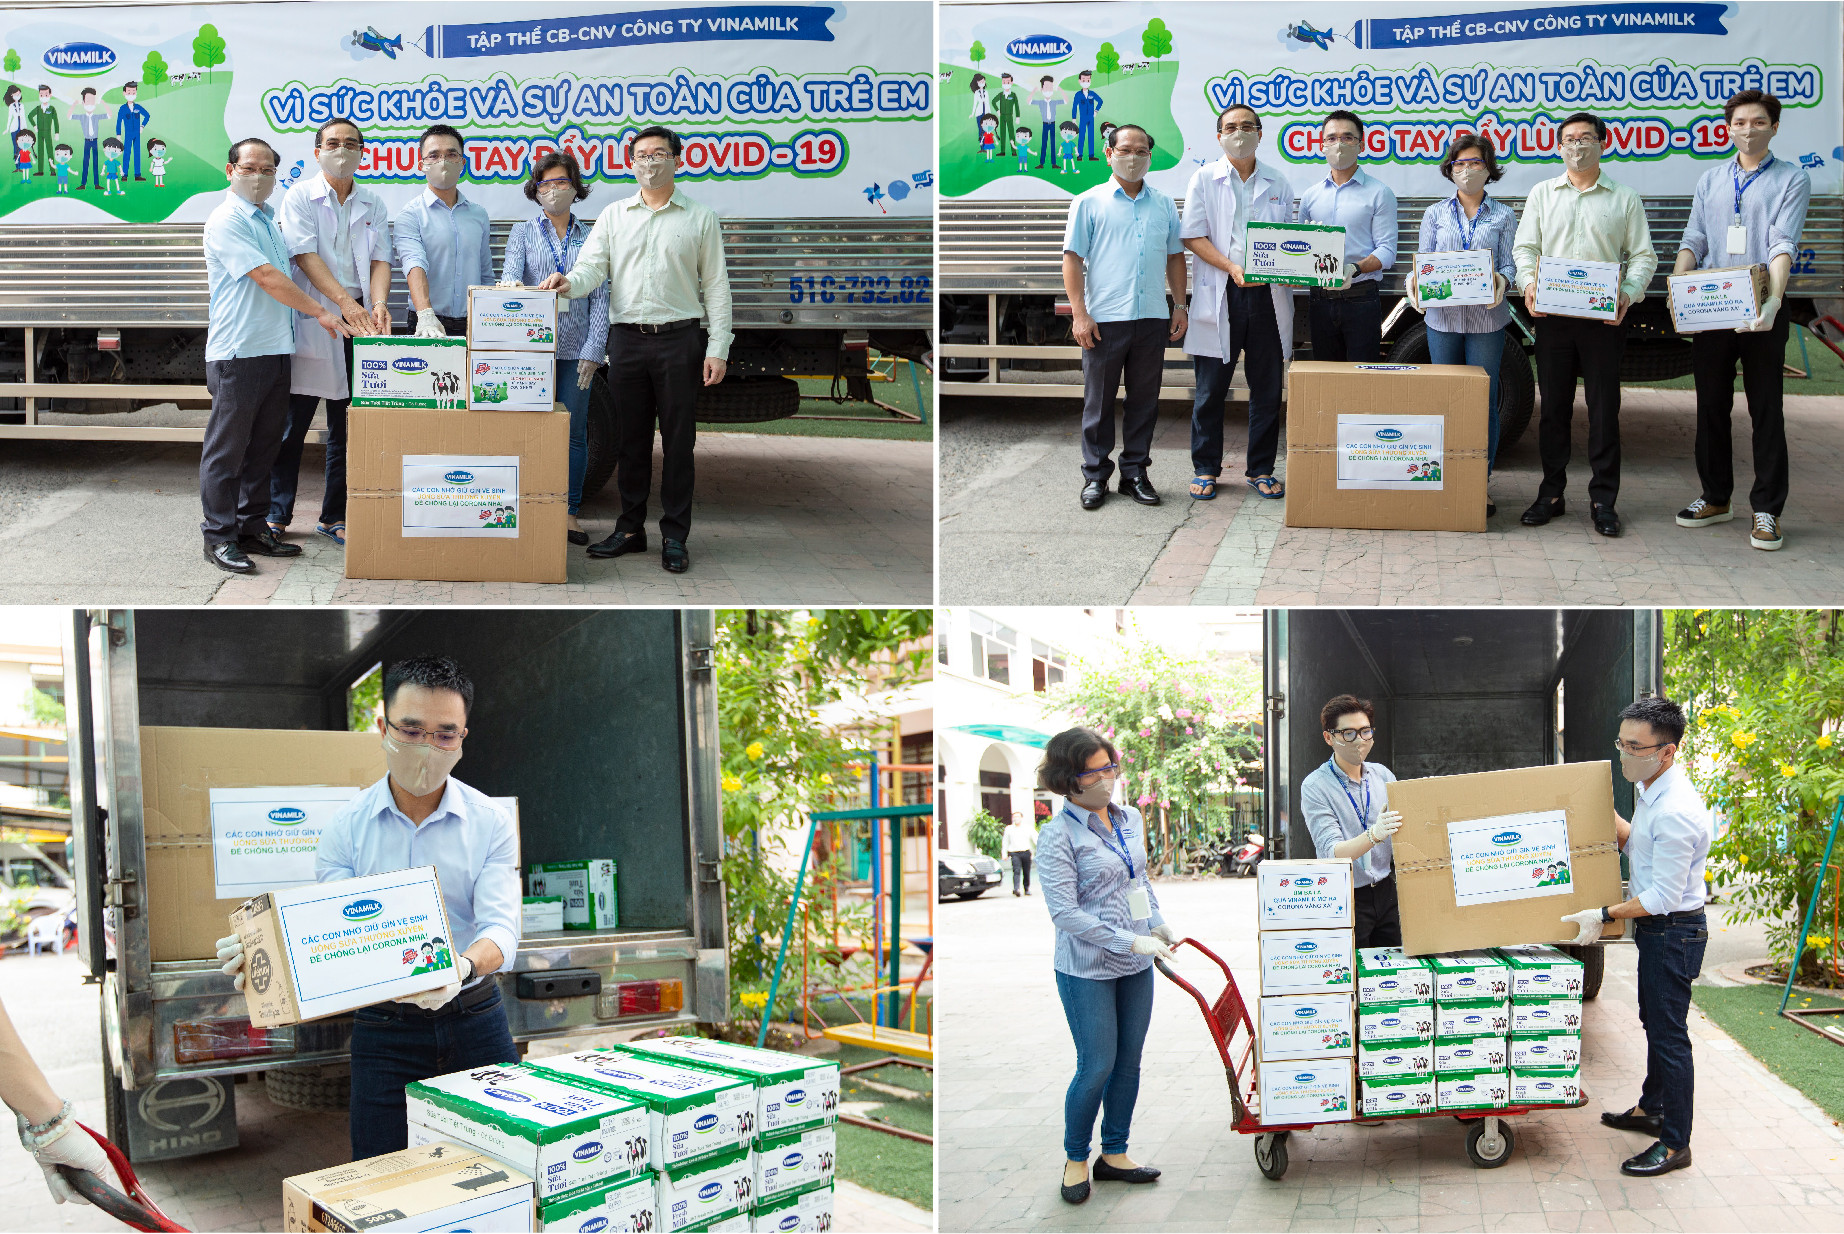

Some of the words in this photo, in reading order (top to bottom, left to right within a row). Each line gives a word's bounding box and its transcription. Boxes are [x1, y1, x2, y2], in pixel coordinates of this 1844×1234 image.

[467, 34, 501, 51] TẬP
[506, 26, 542, 46] THỂ
[546, 26, 616, 44] CB-CNV
[621, 18, 674, 38] CÔNG
[678, 18, 703, 34] TY
[707, 16, 799, 33] VINAMILK
[1393, 28, 1424, 44] TẬP
[1428, 20, 1461, 39] THỂ
[1465, 19, 1529, 37] CB-CNV
[1533, 14, 1581, 32] CÔNG
[1586, 14, 1608, 28] TY
[1611, 12, 1696, 27] VINAMILK
[1011, 41, 1070, 56] VINAMILK
[48, 49, 113, 66] VINAMILK
[1212, 76, 1244, 109] VÌ
[1249, 74, 1309, 108] SỨC
[1311, 70, 1393, 107] KHỎE
[1395, 68, 1439, 105] VÀ
[1442, 68, 1488, 110] SỰ
[1489, 73, 1535, 104] AN
[1539, 64, 1625, 102] TOÀN
[1629, 64, 1698, 101] CỦA
[1700, 64, 1763, 99] TRẺ
[1767, 71, 1814, 99] EM
[270, 88, 304, 123] VÌ
[309, 86, 374, 121] SỨC
[379, 81, 468, 120] KHỎE
[470, 79, 518, 119] VÀ
[522, 78, 571, 125] SỰ
[572, 82, 623, 117] AN
[627, 74, 721, 116] TOÀN
[727, 74, 801, 114] CỦA
[804, 74, 873, 113] TRẺ
[877, 81, 929, 112] EM
[1288, 130, 1386, 152] CHG
[1394, 129, 1446, 152] TAY
[1697, 125, 1730, 147] 19
[469, 146, 524, 171] TAY
[800, 139, 836, 165] 19
[1254, 242, 1276, 250] 100%
[1282, 243, 1312, 251] VINAMILK
[362, 361, 387, 370] 100%
[394, 360, 428, 369] VINAMILK
[361, 371, 379, 380] Sữa
[361, 380, 387, 389] Tươi
[270, 811, 304, 819] VINAMILK
[245, 830, 263, 838] CON
[290, 845, 317, 853] CORON
[344, 902, 381, 915] VINAMILK
[301, 934, 320, 945] CÁC
[322, 930, 341, 941] CON
[381, 918, 396, 930] GÌN
[409, 913, 428, 925] SINH
[338, 937, 358, 949] SỮA
[357, 943, 371, 956] LẠI
[372, 938, 407, 951] CORONA
[696, 1116, 718, 1129] VINAMILK
[149, 1130, 222, 1157] HINO
[673, 1132, 688, 1142] 100%
[574, 1144, 602, 1158] VINAMILK
[549, 1162, 566, 1174] 100%
[365, 1214, 385, 1224] 500
